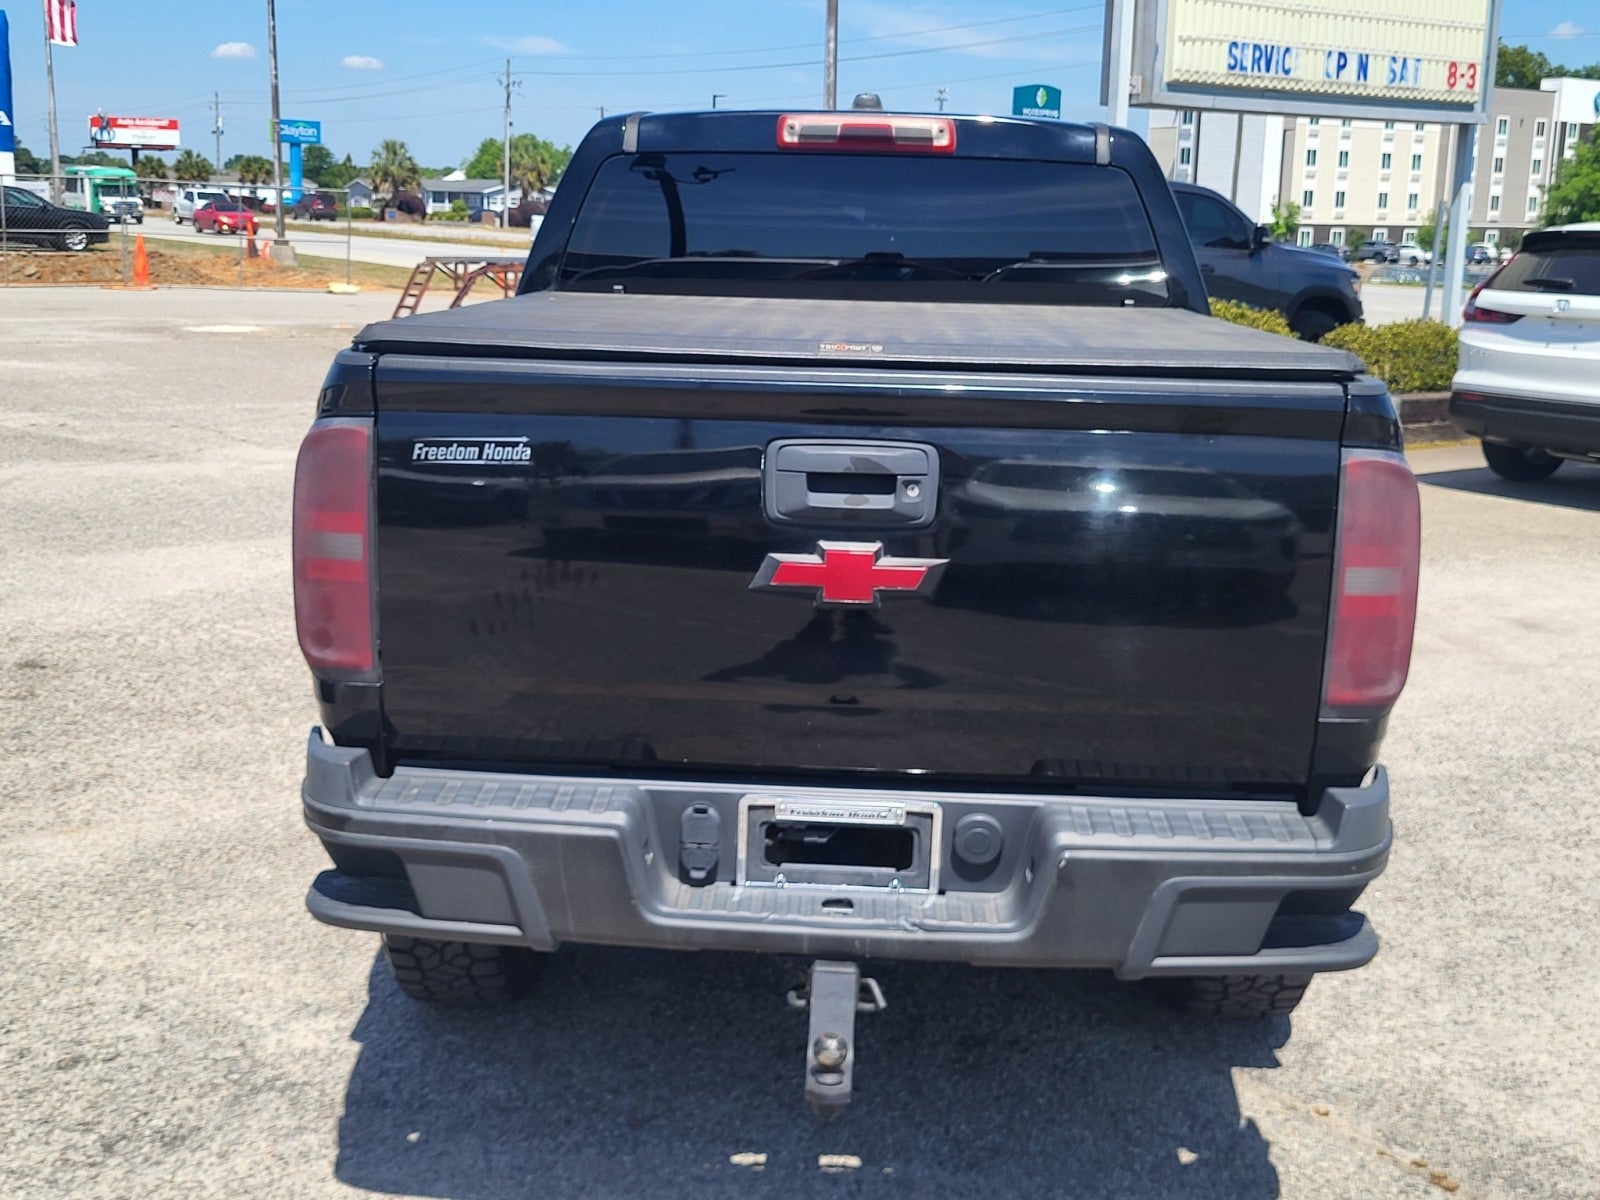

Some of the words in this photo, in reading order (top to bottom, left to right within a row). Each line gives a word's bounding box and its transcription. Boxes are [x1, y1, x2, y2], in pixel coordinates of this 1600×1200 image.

[1447, 61, 1477, 89] 8-3
[412, 443, 479, 460] Freedom
[482, 443, 531, 460] Honda
